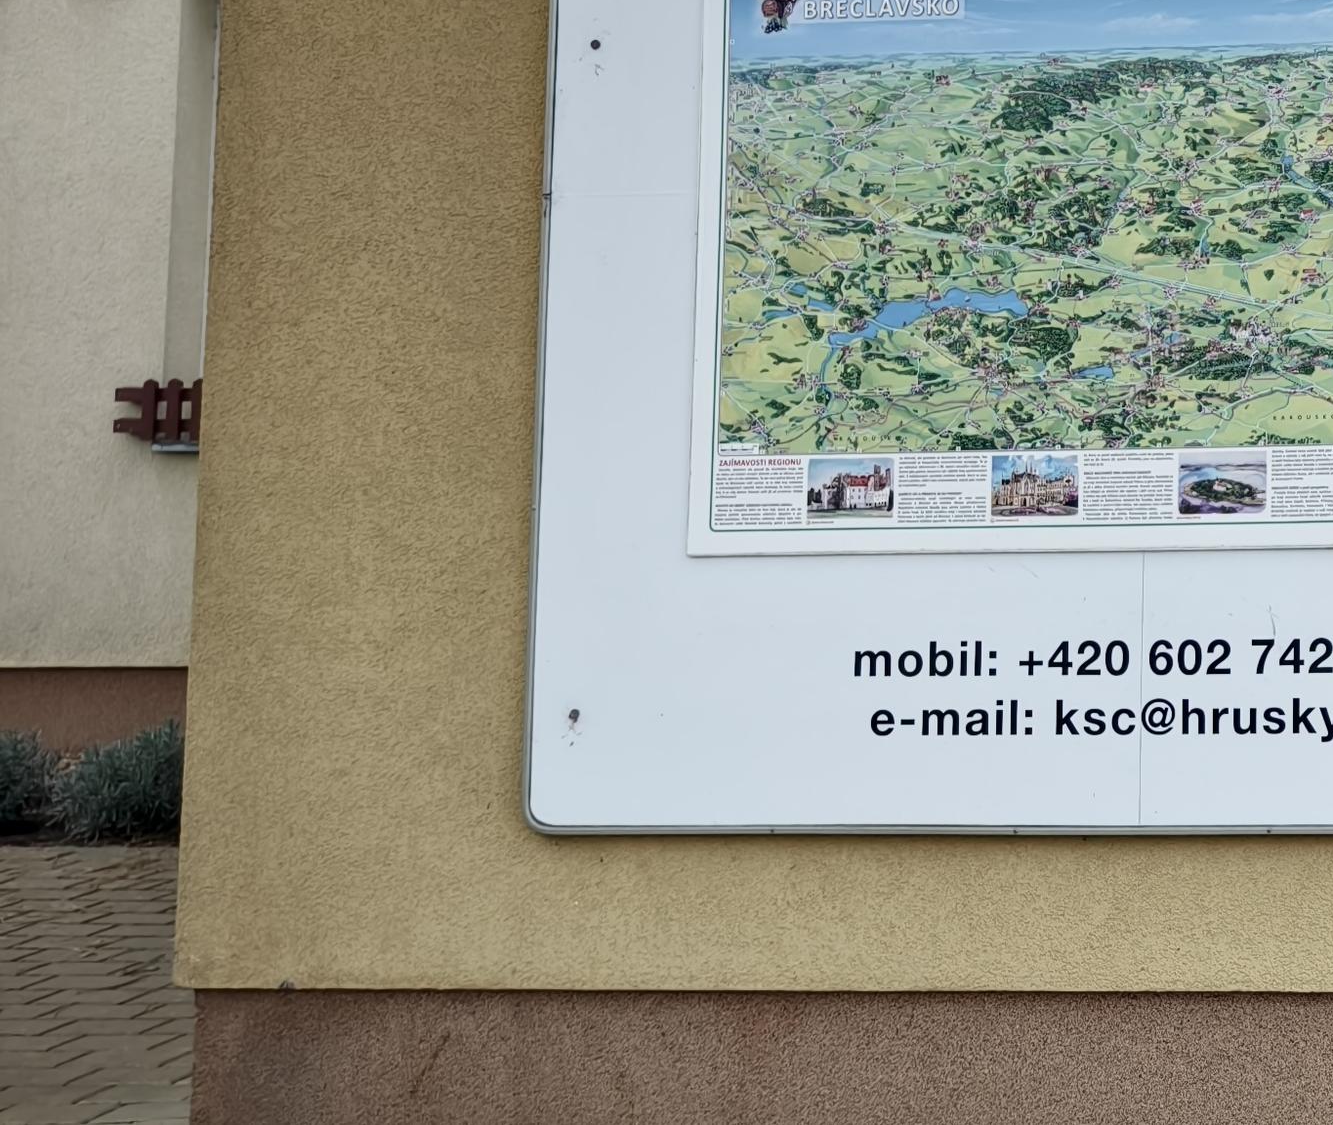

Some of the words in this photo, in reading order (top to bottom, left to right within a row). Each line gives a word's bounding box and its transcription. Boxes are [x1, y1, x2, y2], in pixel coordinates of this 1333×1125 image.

[718, 457, 767, 467] ZAJÍMAVOSTI
[767, 457, 802, 467] REGIONU
[852, 640, 999, 679] mobil:
[1018, 639, 1131, 677] +420
[1147, 638, 1232, 676] 602
[869, 700, 1035, 737] e-mail:
